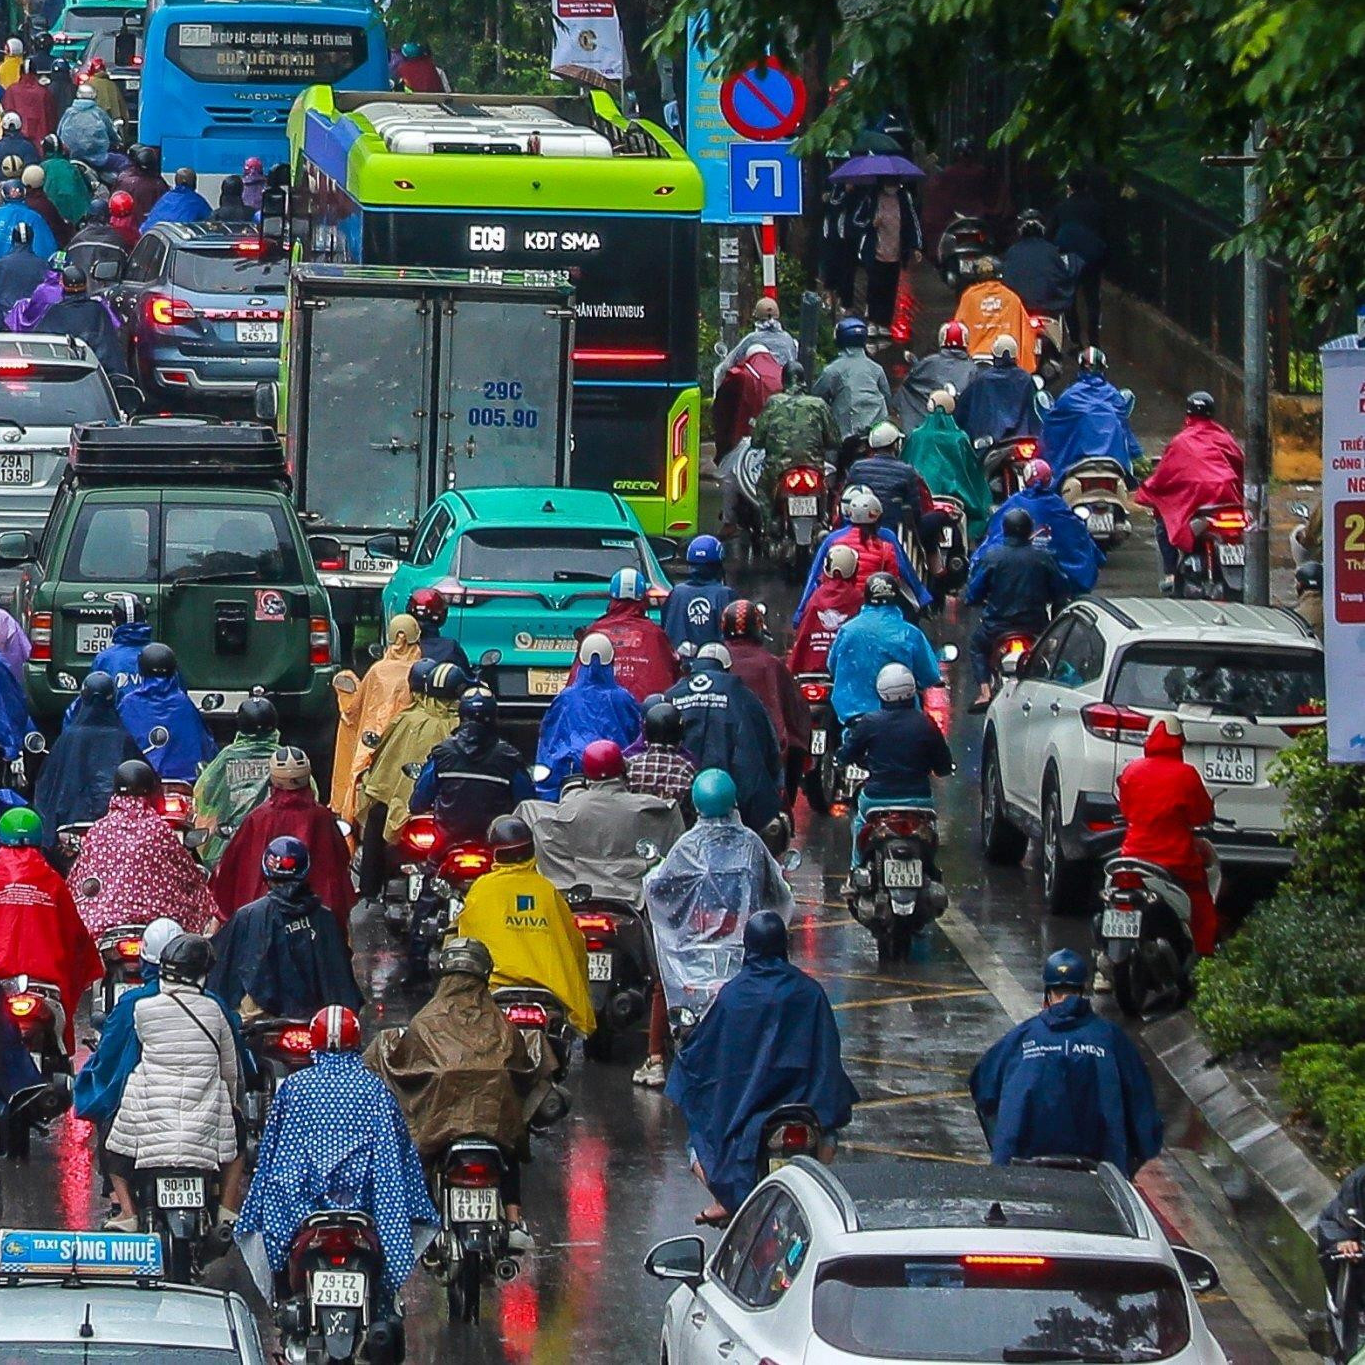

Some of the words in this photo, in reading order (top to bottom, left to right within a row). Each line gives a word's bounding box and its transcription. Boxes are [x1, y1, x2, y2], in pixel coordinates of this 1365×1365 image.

[469, 226, 506, 251] E09
[524, 231, 558, 251] KĐT
[560, 231, 601, 252] SMA
[594, 300, 613, 318] VIÊN
[614, 304, 645, 319] VINBUS
[483, 381, 522, 401] 29C
[468, 407, 538, 428] 005.90
[1, 456, 23, 468] 29A
[612, 480, 660, 491] GREEN
[1217, 747, 1242, 764] 43A
[505, 915, 549, 926] AVIVA
[163, 1178, 198, 1192] 90-D1
[160, 1191, 204, 1206] 083.95
[33, 1238, 59, 1251] TAXI
[110, 1237, 157, 1267] NHUỆ
[322, 1274, 356, 1290] 29-E2
[316, 1289, 358, 1306] 293.49
